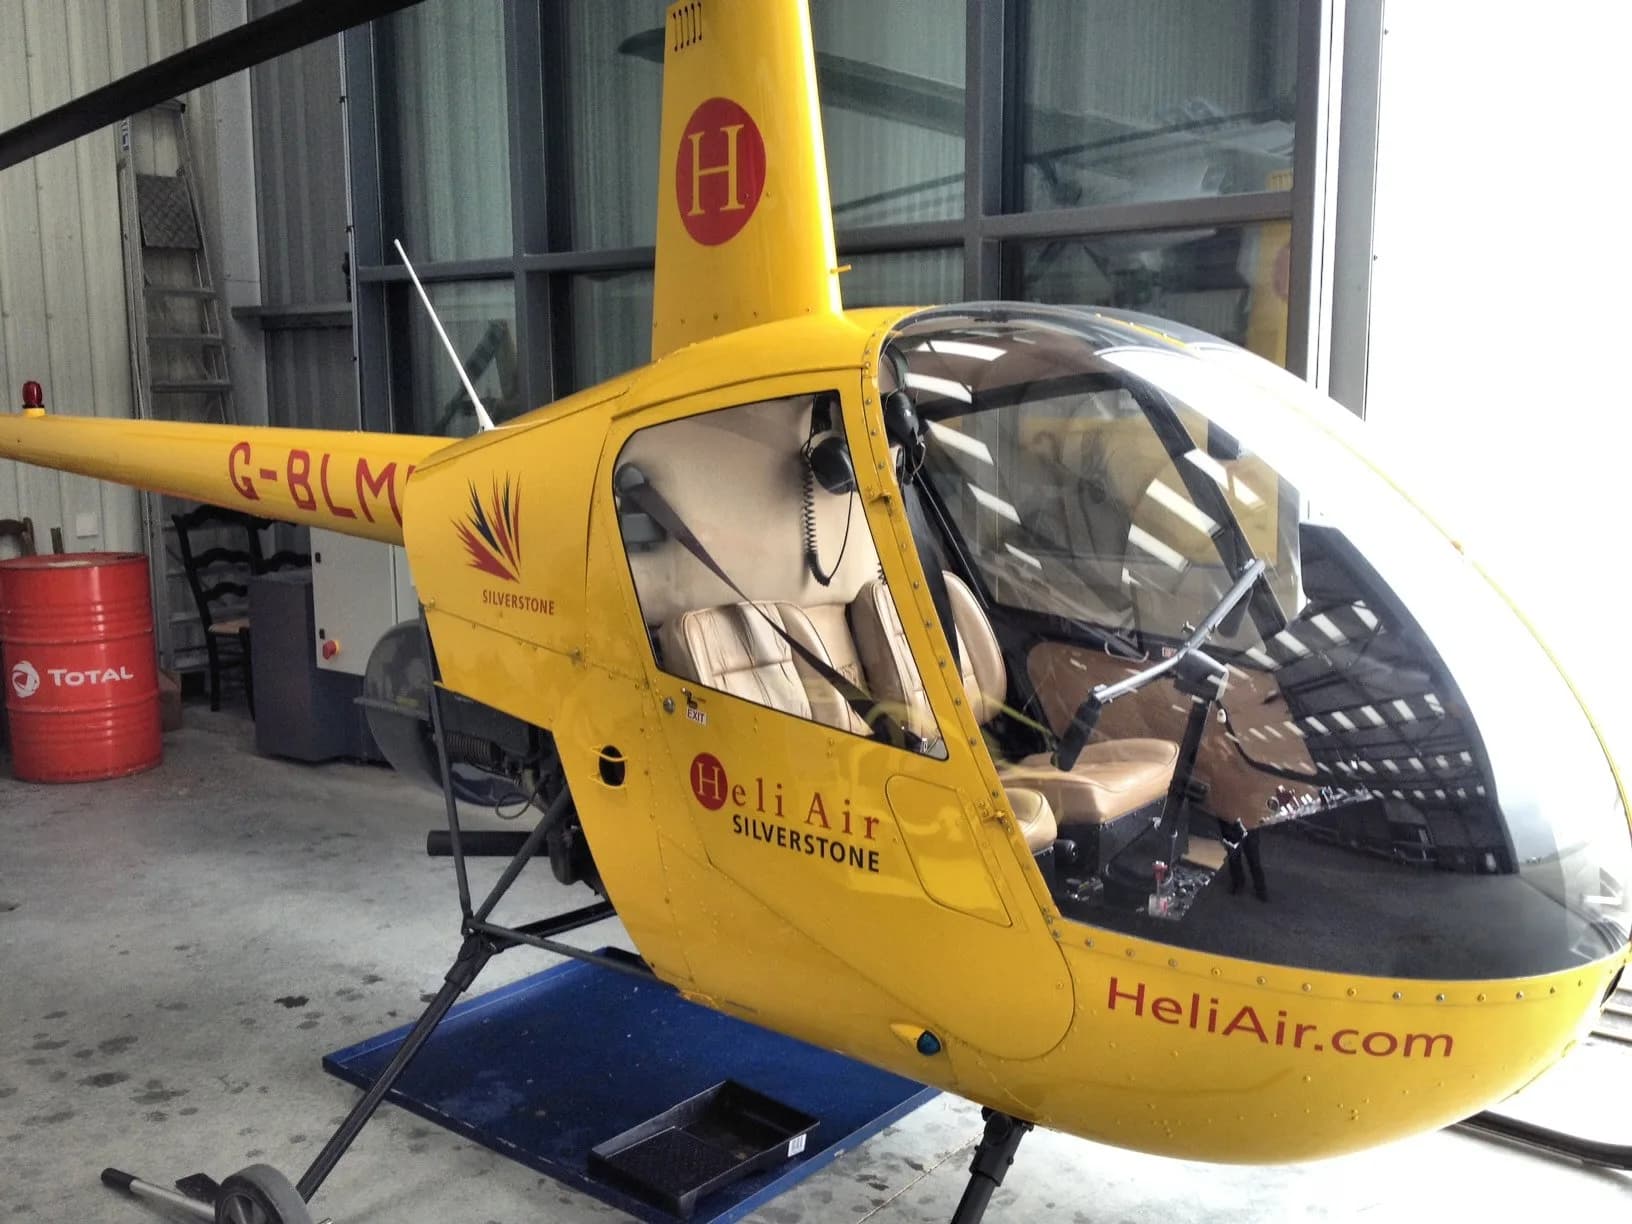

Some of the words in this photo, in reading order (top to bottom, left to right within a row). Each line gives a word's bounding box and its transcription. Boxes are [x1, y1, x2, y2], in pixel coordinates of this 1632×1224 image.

[687, 124, 745, 217] H
[228, 441, 416, 529] G-BLM
[482, 589, 555, 616] SILVERSTONE
[687, 708, 705, 723] EXIT
[696, 761, 785, 818] Heli
[804, 791, 880, 841] Air
[732, 814, 880, 873] SILVERSTONE
[1107, 976, 1455, 1058] HeliAir.com
